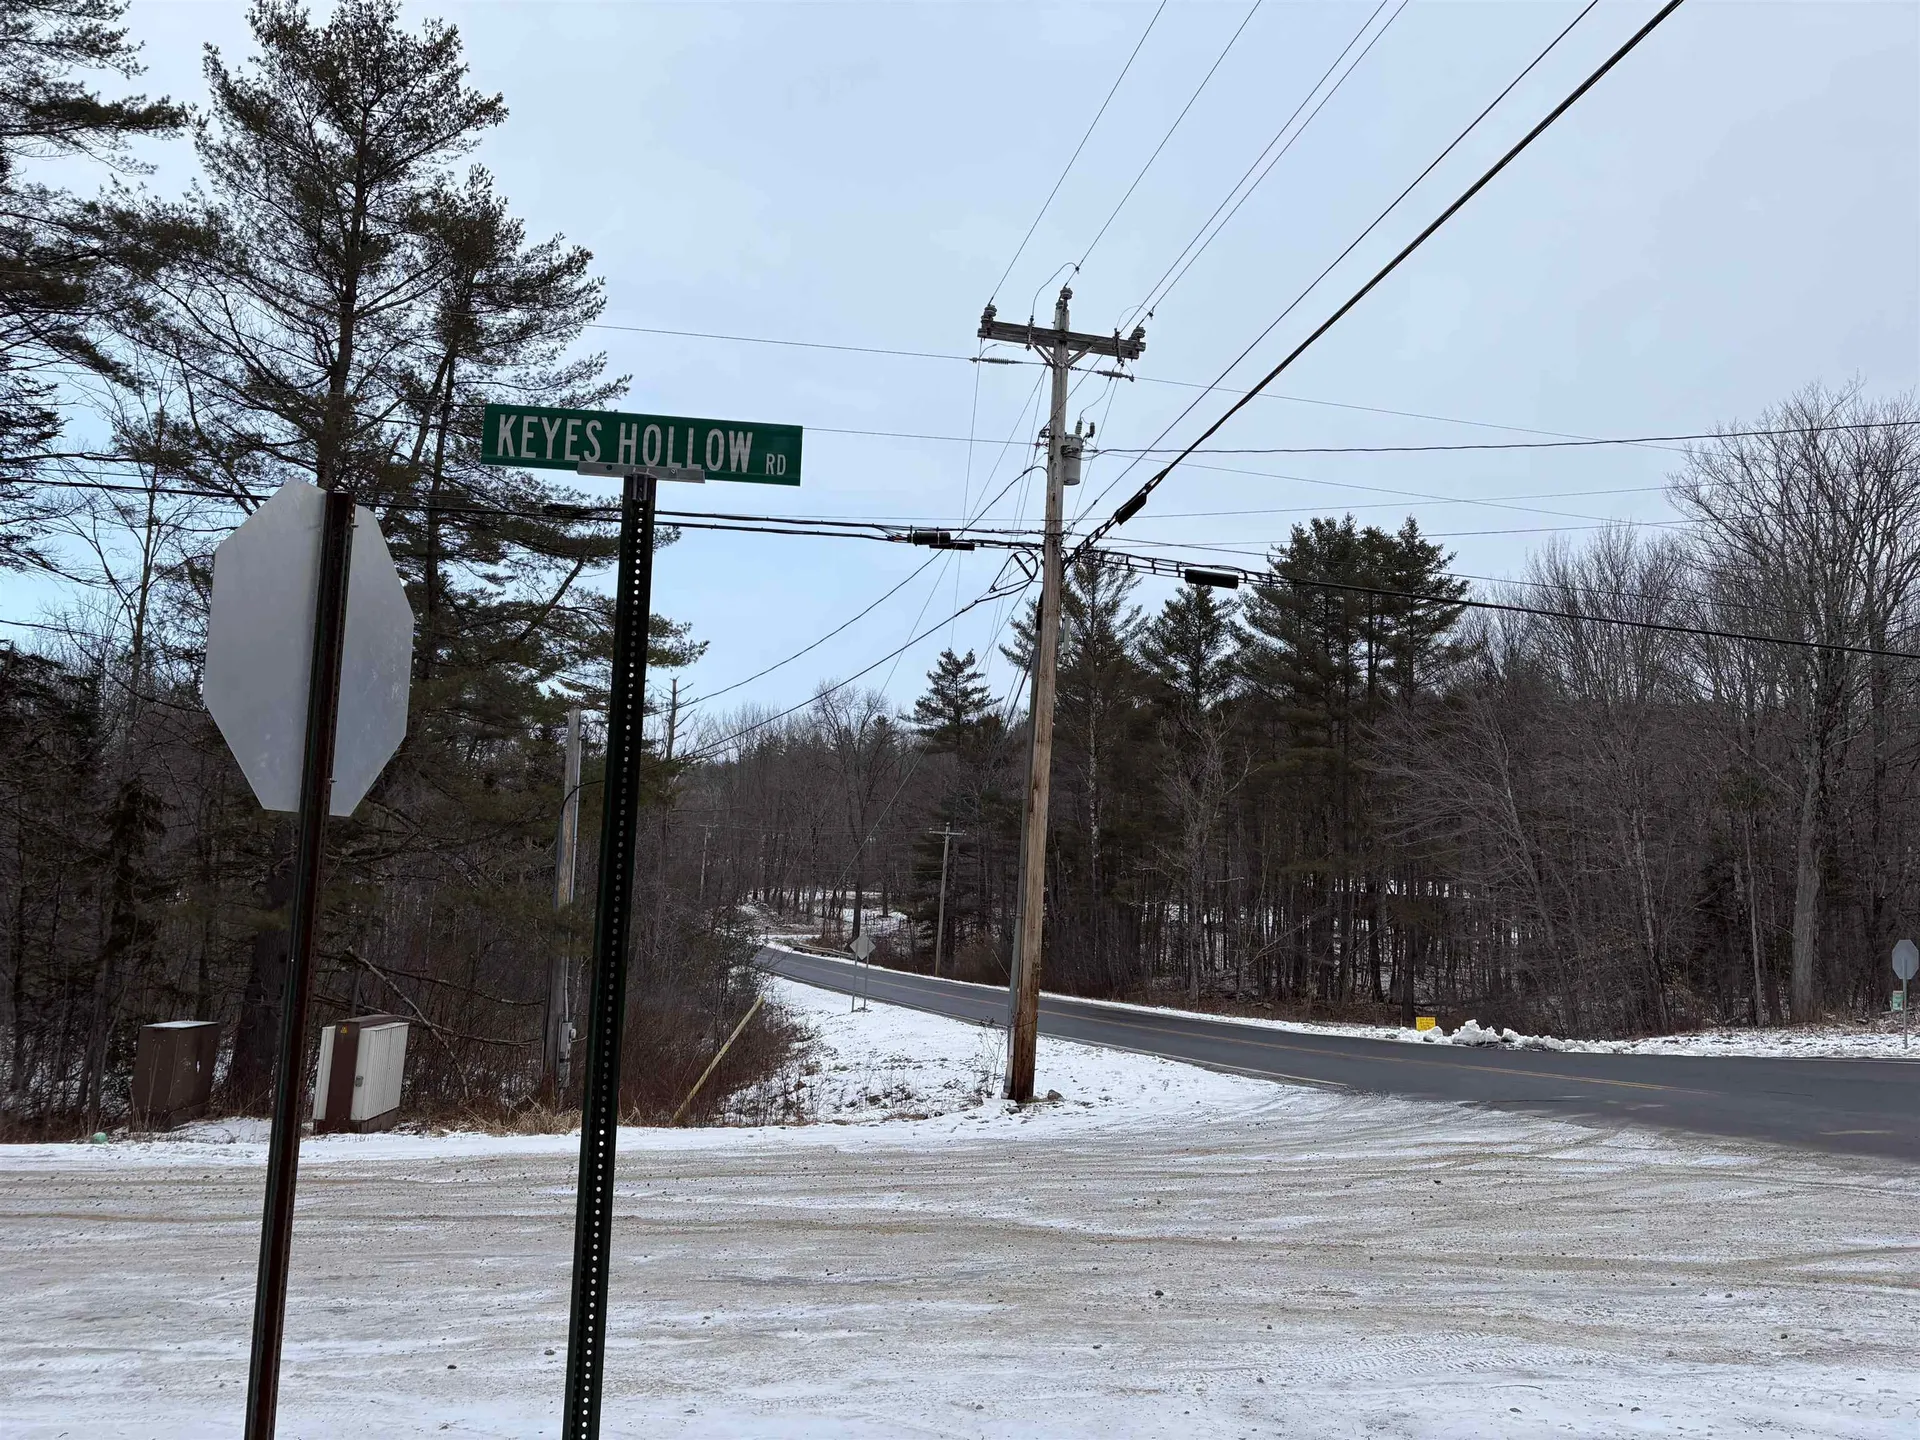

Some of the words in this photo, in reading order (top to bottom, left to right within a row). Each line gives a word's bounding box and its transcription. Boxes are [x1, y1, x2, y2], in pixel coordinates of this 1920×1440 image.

[497, 414, 602, 463] KEYES
[618, 422, 753, 473] HOLLOW
[765, 453, 786, 475] RD
